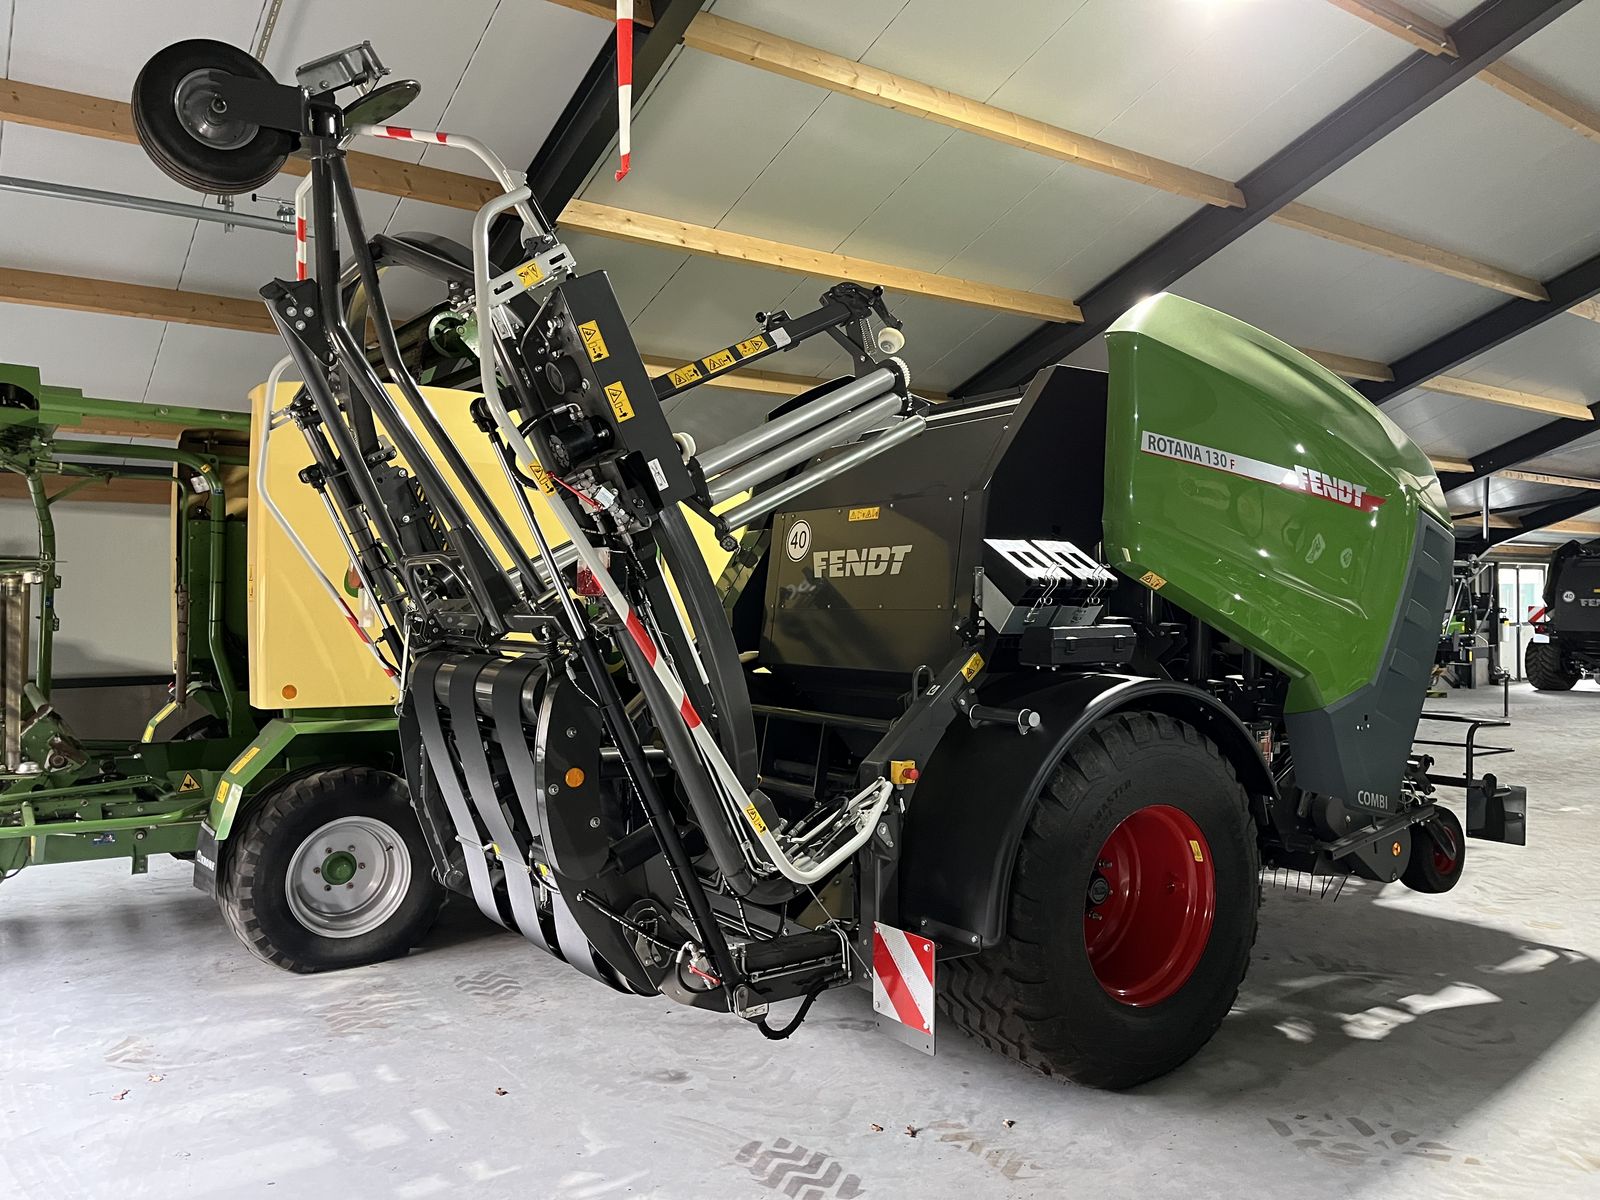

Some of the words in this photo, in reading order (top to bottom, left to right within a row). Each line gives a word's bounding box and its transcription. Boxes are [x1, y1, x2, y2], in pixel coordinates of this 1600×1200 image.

[1148, 434, 1202, 462] ROTANA
[1206, 450, 1227, 468] 130
[1230, 459, 1235, 470] F
[1294, 464, 1367, 507] FENDT
[790, 530, 807, 549] 40
[813, 544, 913, 578] FENDT
[1358, 790, 1388, 810] COMBI
